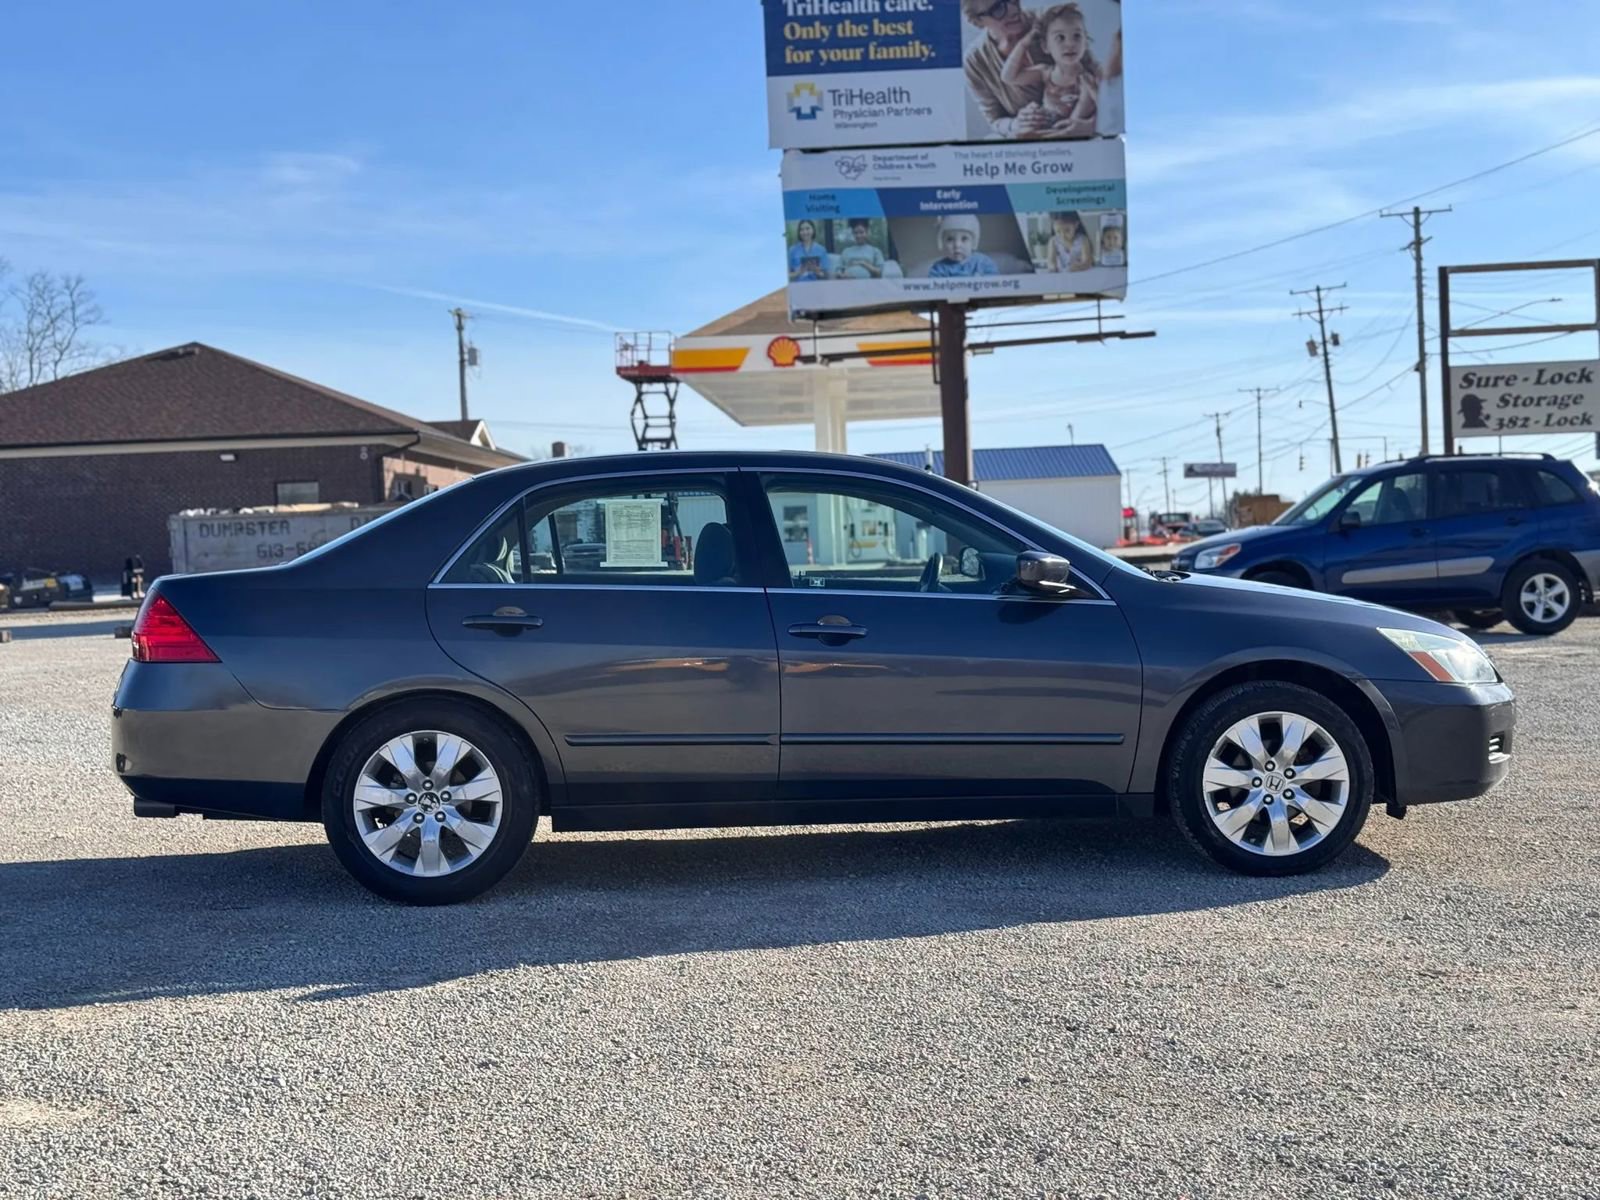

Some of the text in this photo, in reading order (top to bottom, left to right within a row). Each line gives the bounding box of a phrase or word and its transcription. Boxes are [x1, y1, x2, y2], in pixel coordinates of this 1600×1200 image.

[783, 18, 914, 42] Only the best
[785, 40, 936, 66] for your family.
[827, 86, 911, 107] TriHealth
[833, 105, 933, 121] Physician Partners
[963, 160, 1073, 179] Help Me Grow
[936, 189, 962, 202] Early
[1045, 183, 1116, 195] Developmental
[919, 200, 979, 211] Intervention
[903, 279, 1021, 292] www.helpmegrow.org
[1459, 372, 1518, 390] Sure
[1533, 366, 1594, 386] Lock
[1496, 392, 1585, 411] Storage
[1543, 411, 1593, 428] Lock
